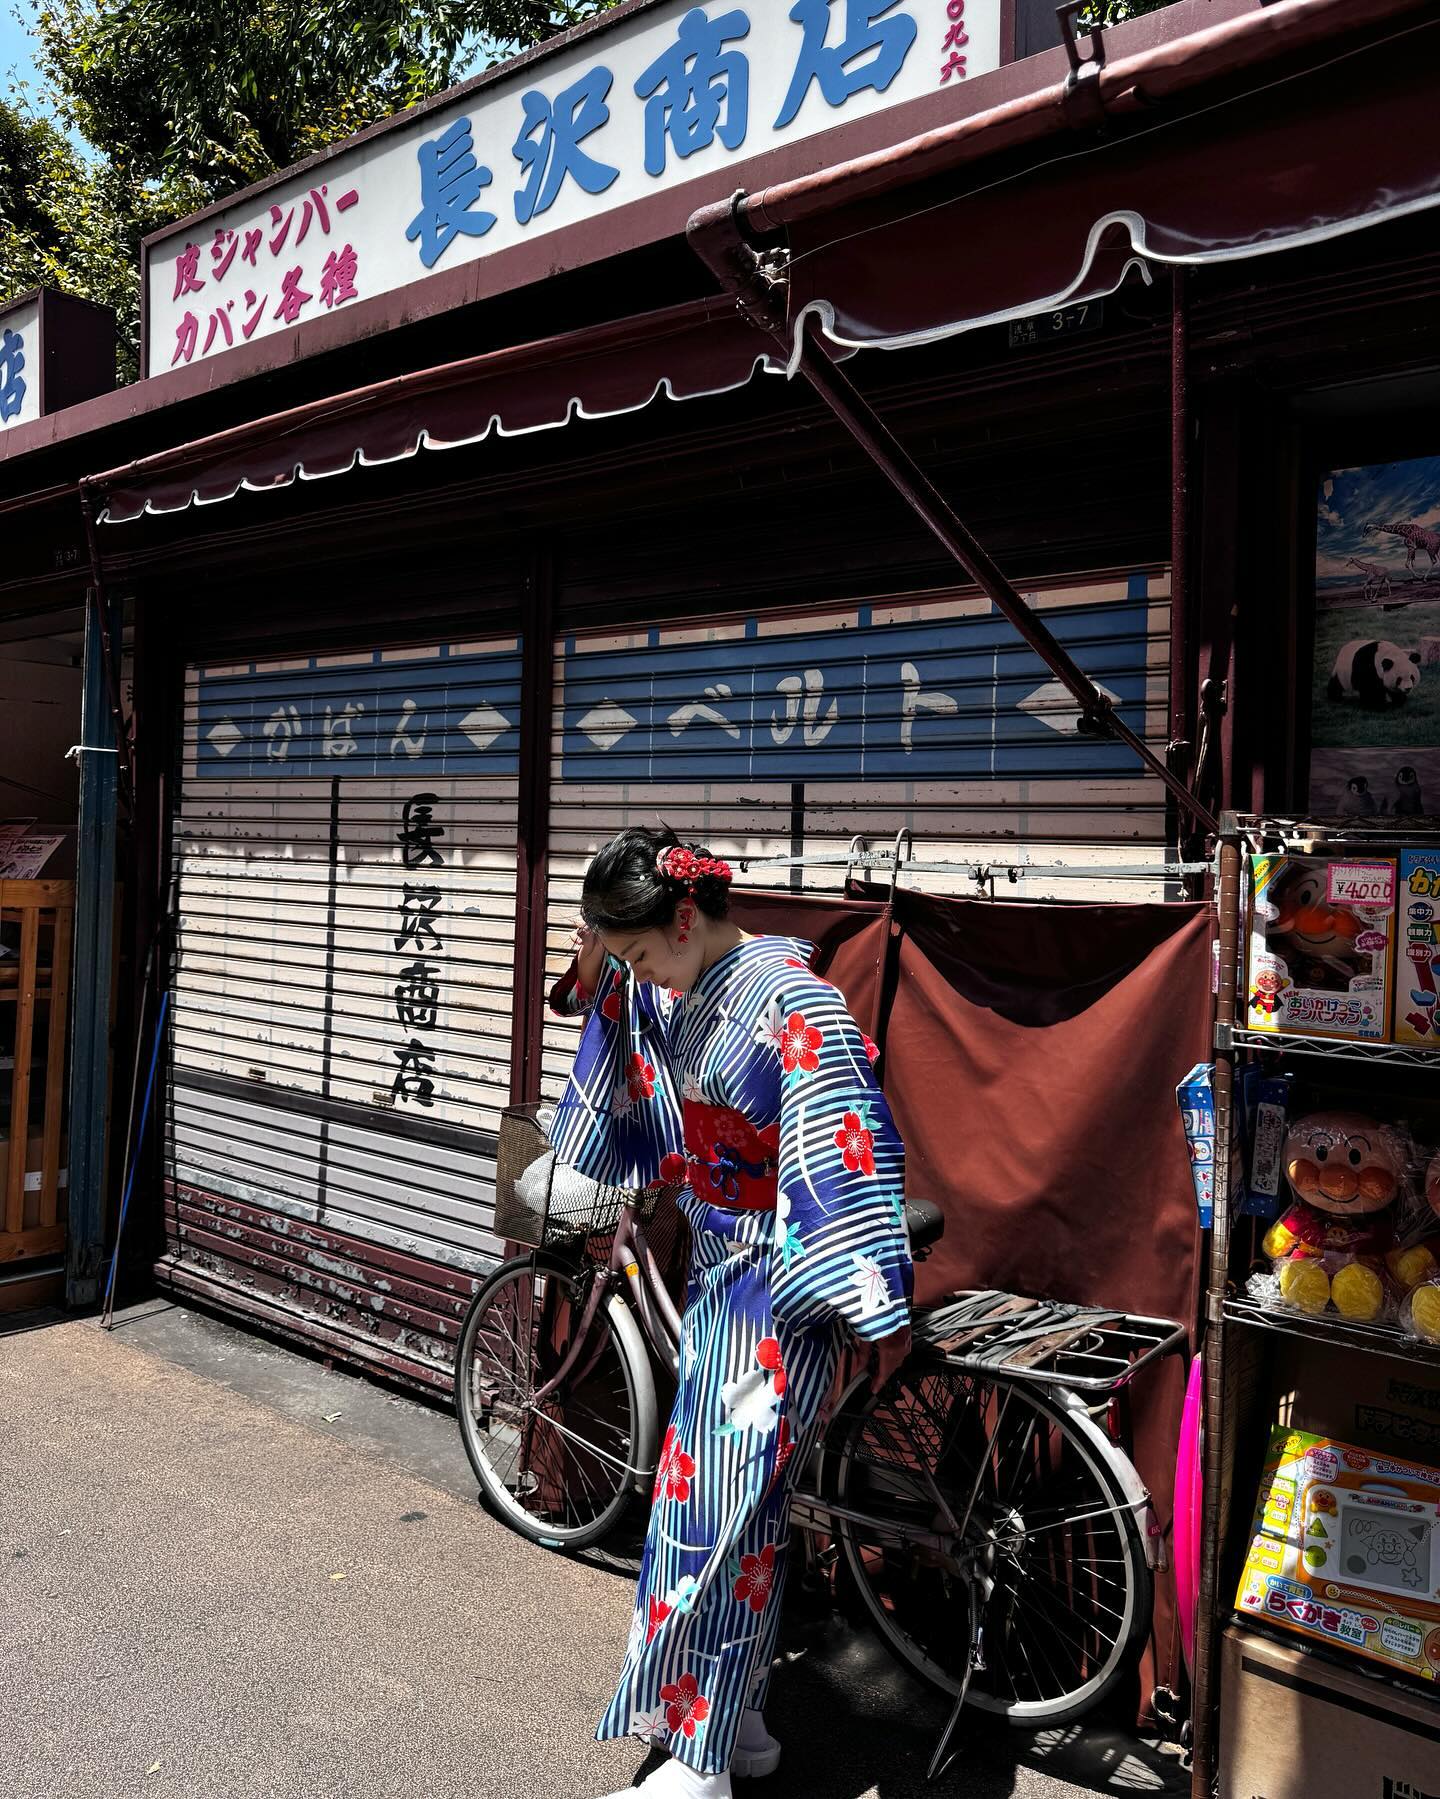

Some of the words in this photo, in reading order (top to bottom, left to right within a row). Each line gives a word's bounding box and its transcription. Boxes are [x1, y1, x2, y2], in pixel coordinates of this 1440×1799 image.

[405, 0, 918, 268] 長沢商店
[173, 184, 360, 302] 皮ジャンパー
[170, 243, 359, 366] カバン各種
[1052, 305, 1089, 331] 3-7
[262, 699, 428, 765] かばん
[666, 661, 959, 756] ベルト
[392, 793, 445, 1108] 長沢商店
[1289, 997, 1362, 1014] おいかけっこ
[1268, 1591, 1342, 1632] らくがき
[1339, 1623, 1363, 1640] 教室
